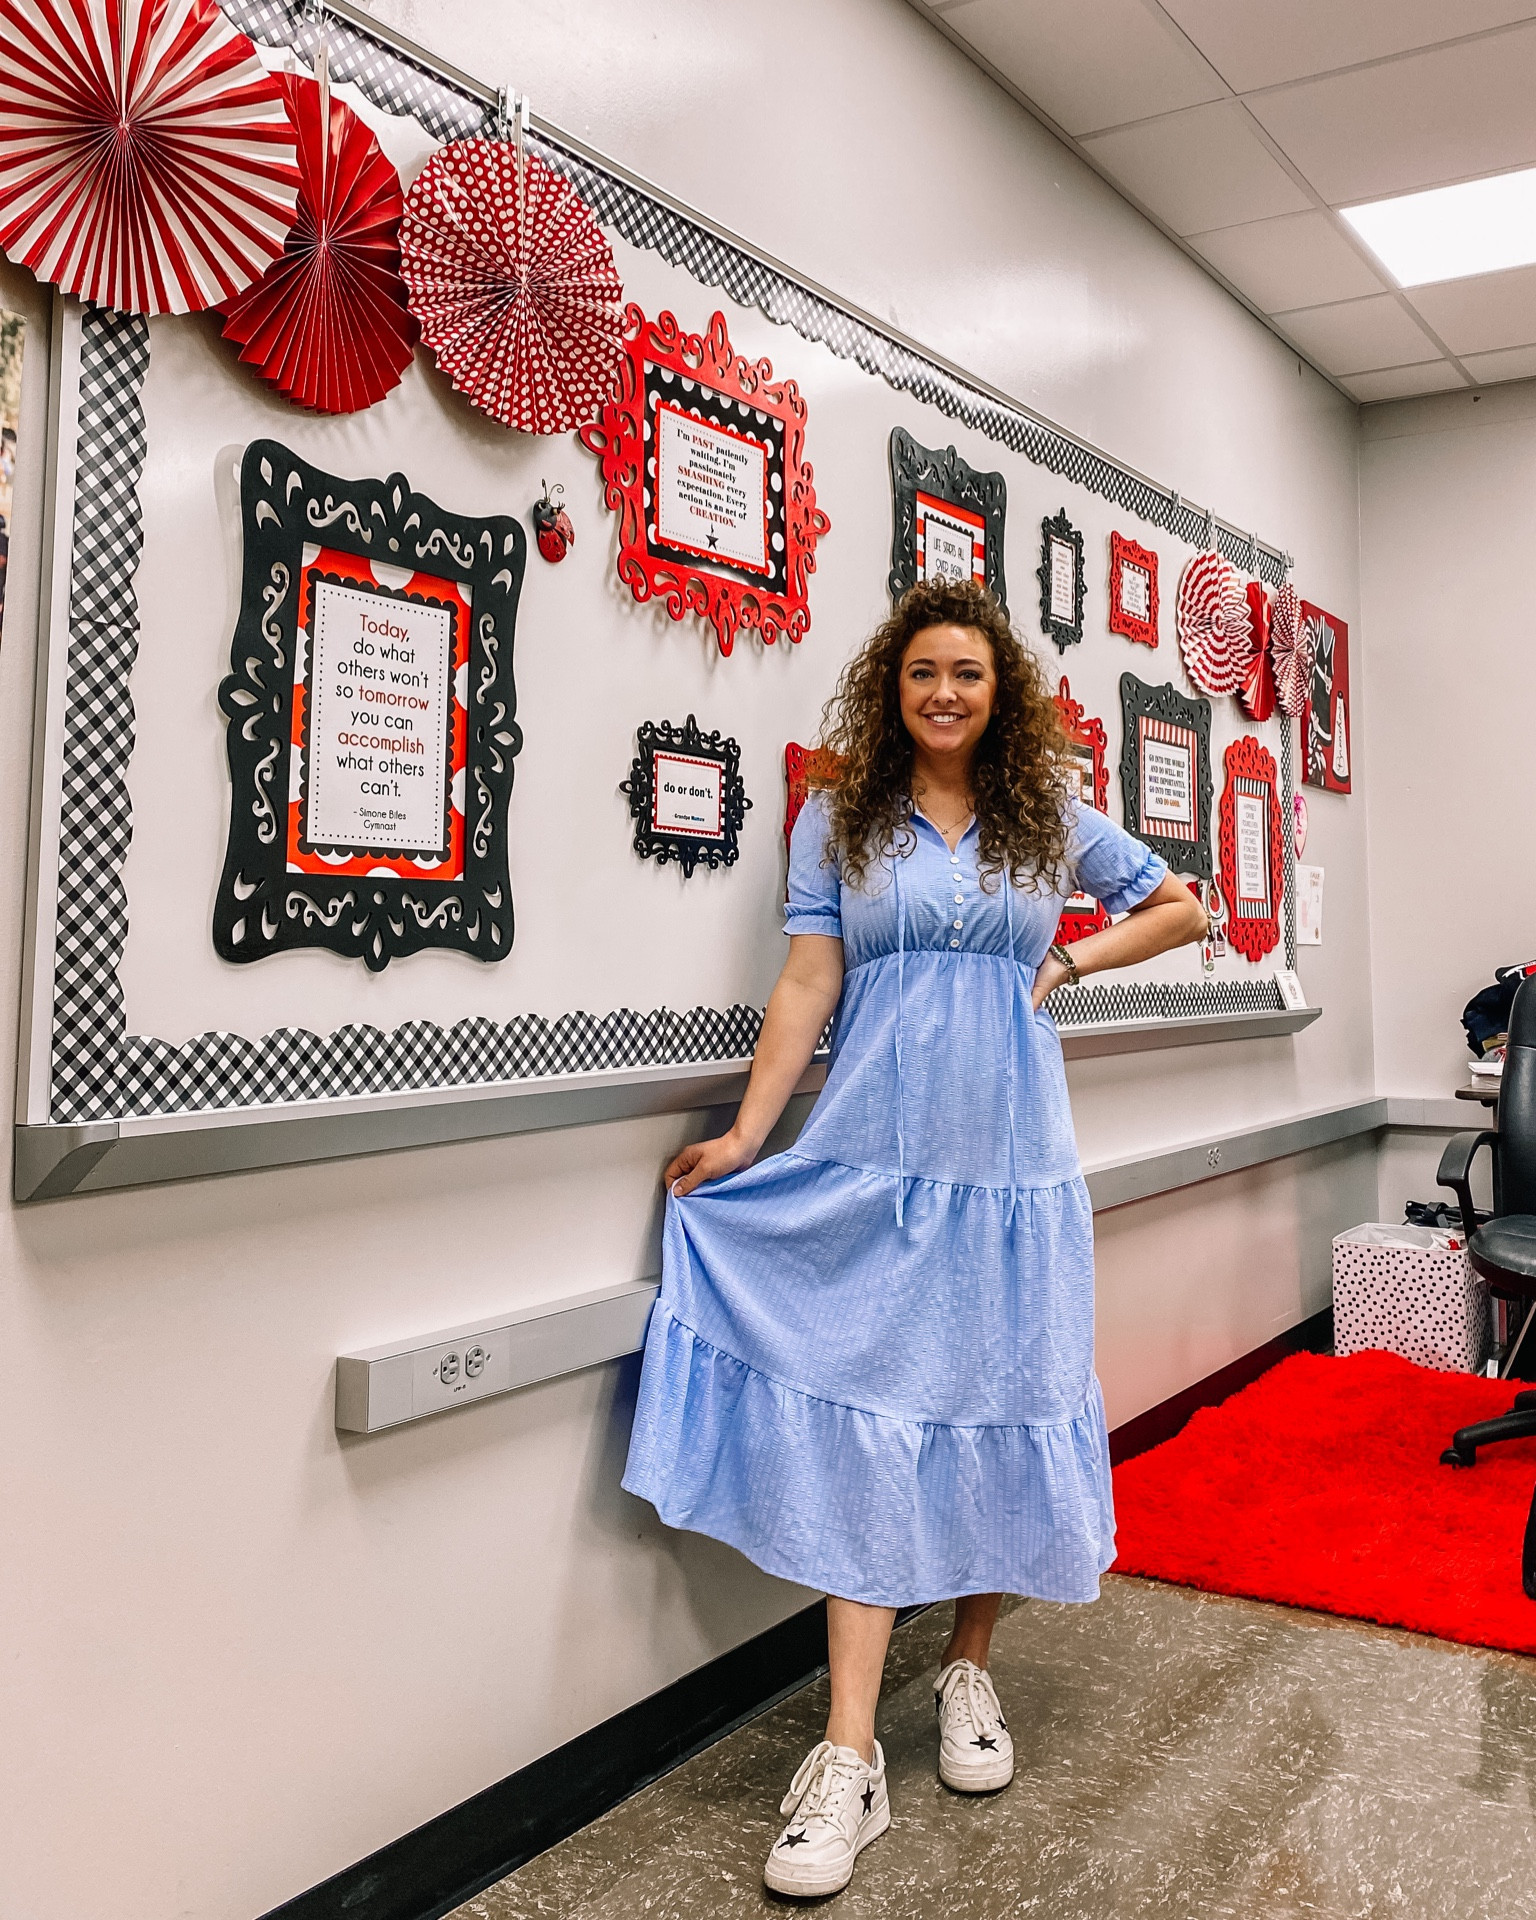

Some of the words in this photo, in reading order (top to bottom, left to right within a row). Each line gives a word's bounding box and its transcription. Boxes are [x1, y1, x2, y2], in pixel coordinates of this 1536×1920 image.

[677, 428, 690, 442] I'm
[692, 434, 715, 451] PAST
[716, 446, 749, 466] patiently
[690, 448, 721, 466] waiting.
[723, 459, 736, 472] I'm
[677, 464, 725, 490] SMASHING
[726, 485, 747, 500] every
[689, 459, 737, 485] passionately
[677, 478, 725, 502] expectation.
[726, 495, 748, 511] Every
[678, 491, 703, 507] action
[705, 499, 712, 509] is
[714, 503, 724, 513] an
[725, 506, 737, 518] act
[738, 512, 747, 521] of
[689, 505, 737, 529] CREATION.
[360, 614, 410, 642] Today,
[353, 637, 375, 656] do
[380, 643, 416, 664] what
[337, 659, 385, 681] others
[390, 671, 429, 689] won't
[335, 685, 354, 699] so
[359, 685, 429, 711] tomorrow
[351, 711, 379, 726] you
[384, 715, 413, 731] can
[338, 732, 425, 755] accomplish
[336, 751, 374, 771] what
[378, 757, 425, 777] others
[360, 780, 401, 797] can't.
[664, 782, 675, 793] do
[678, 786, 687, 795] or
[689, 786, 713, 799] don't.
[359, 807, 387, 819] Simone
[388, 810, 407, 820] Biles
[363, 819, 397, 831] Gymnast
